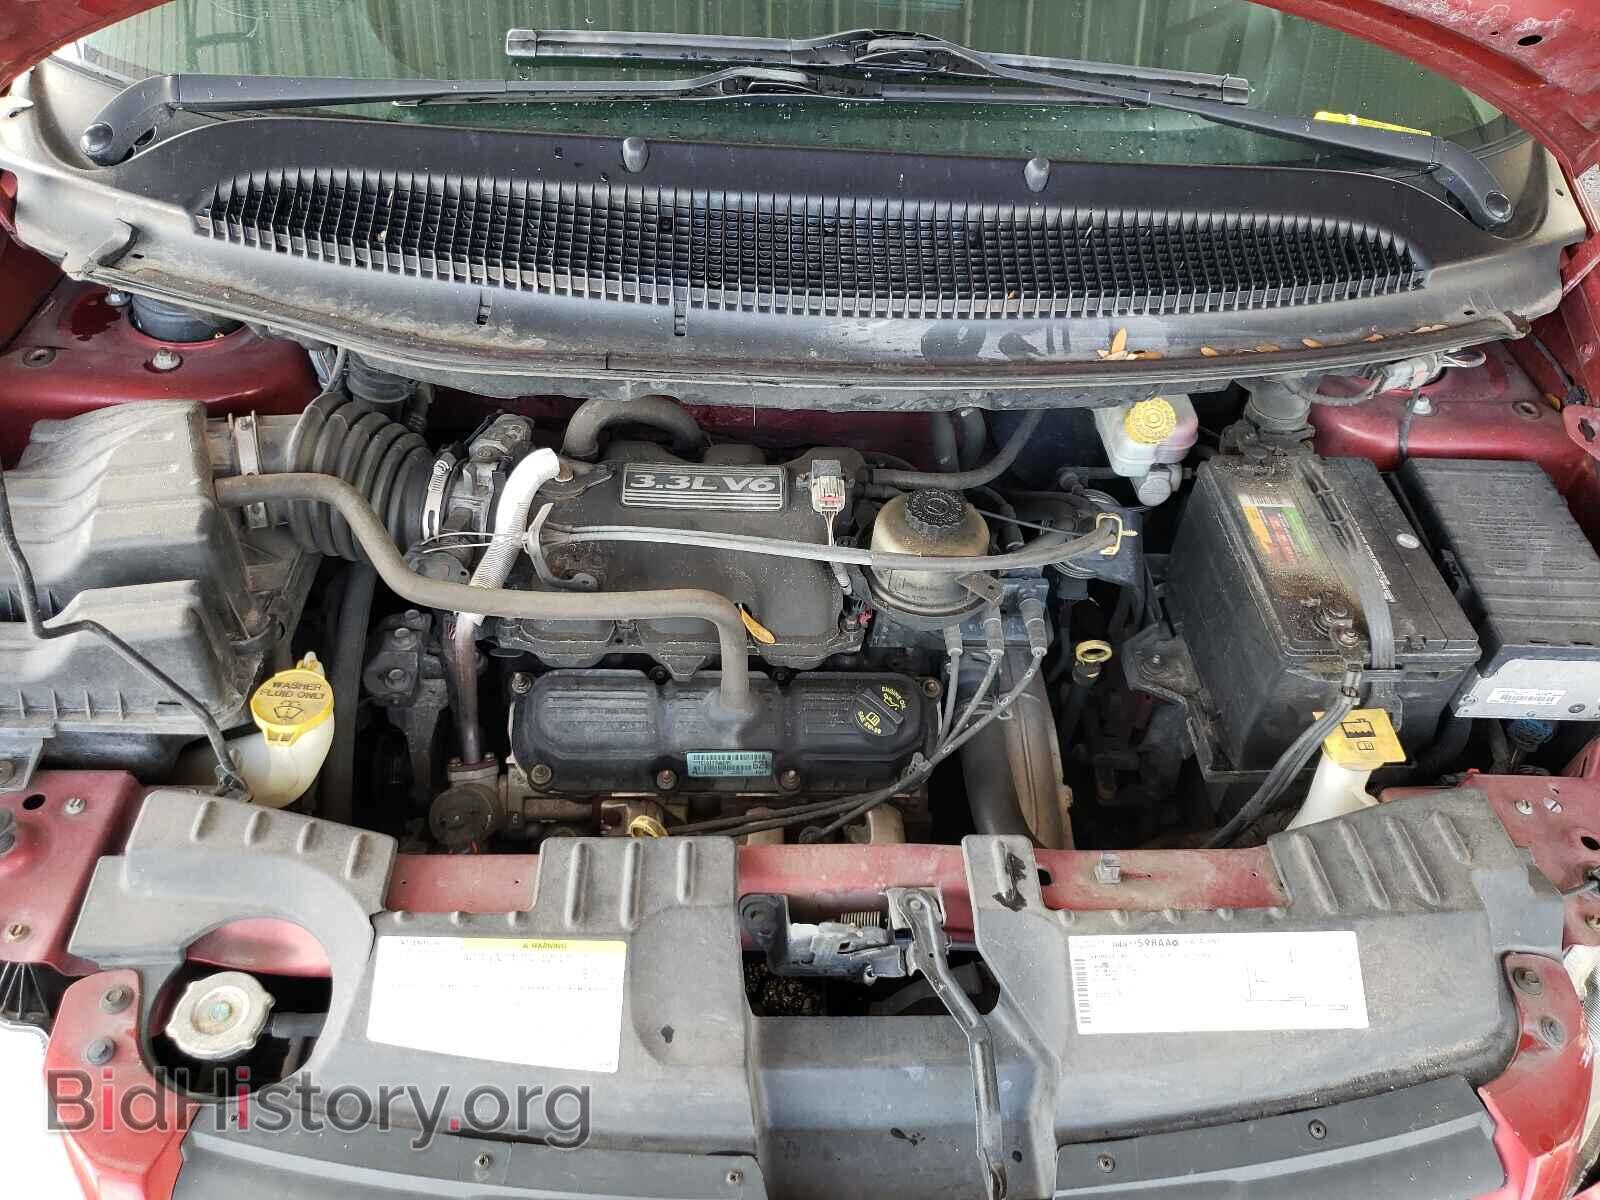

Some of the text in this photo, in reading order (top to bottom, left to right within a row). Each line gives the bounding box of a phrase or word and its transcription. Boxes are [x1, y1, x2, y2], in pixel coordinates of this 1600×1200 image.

[630, 474, 776, 492] 3.3L V6
[273, 682, 322, 691] WASHER
[259, 688, 326, 700] FLUID ONLY
